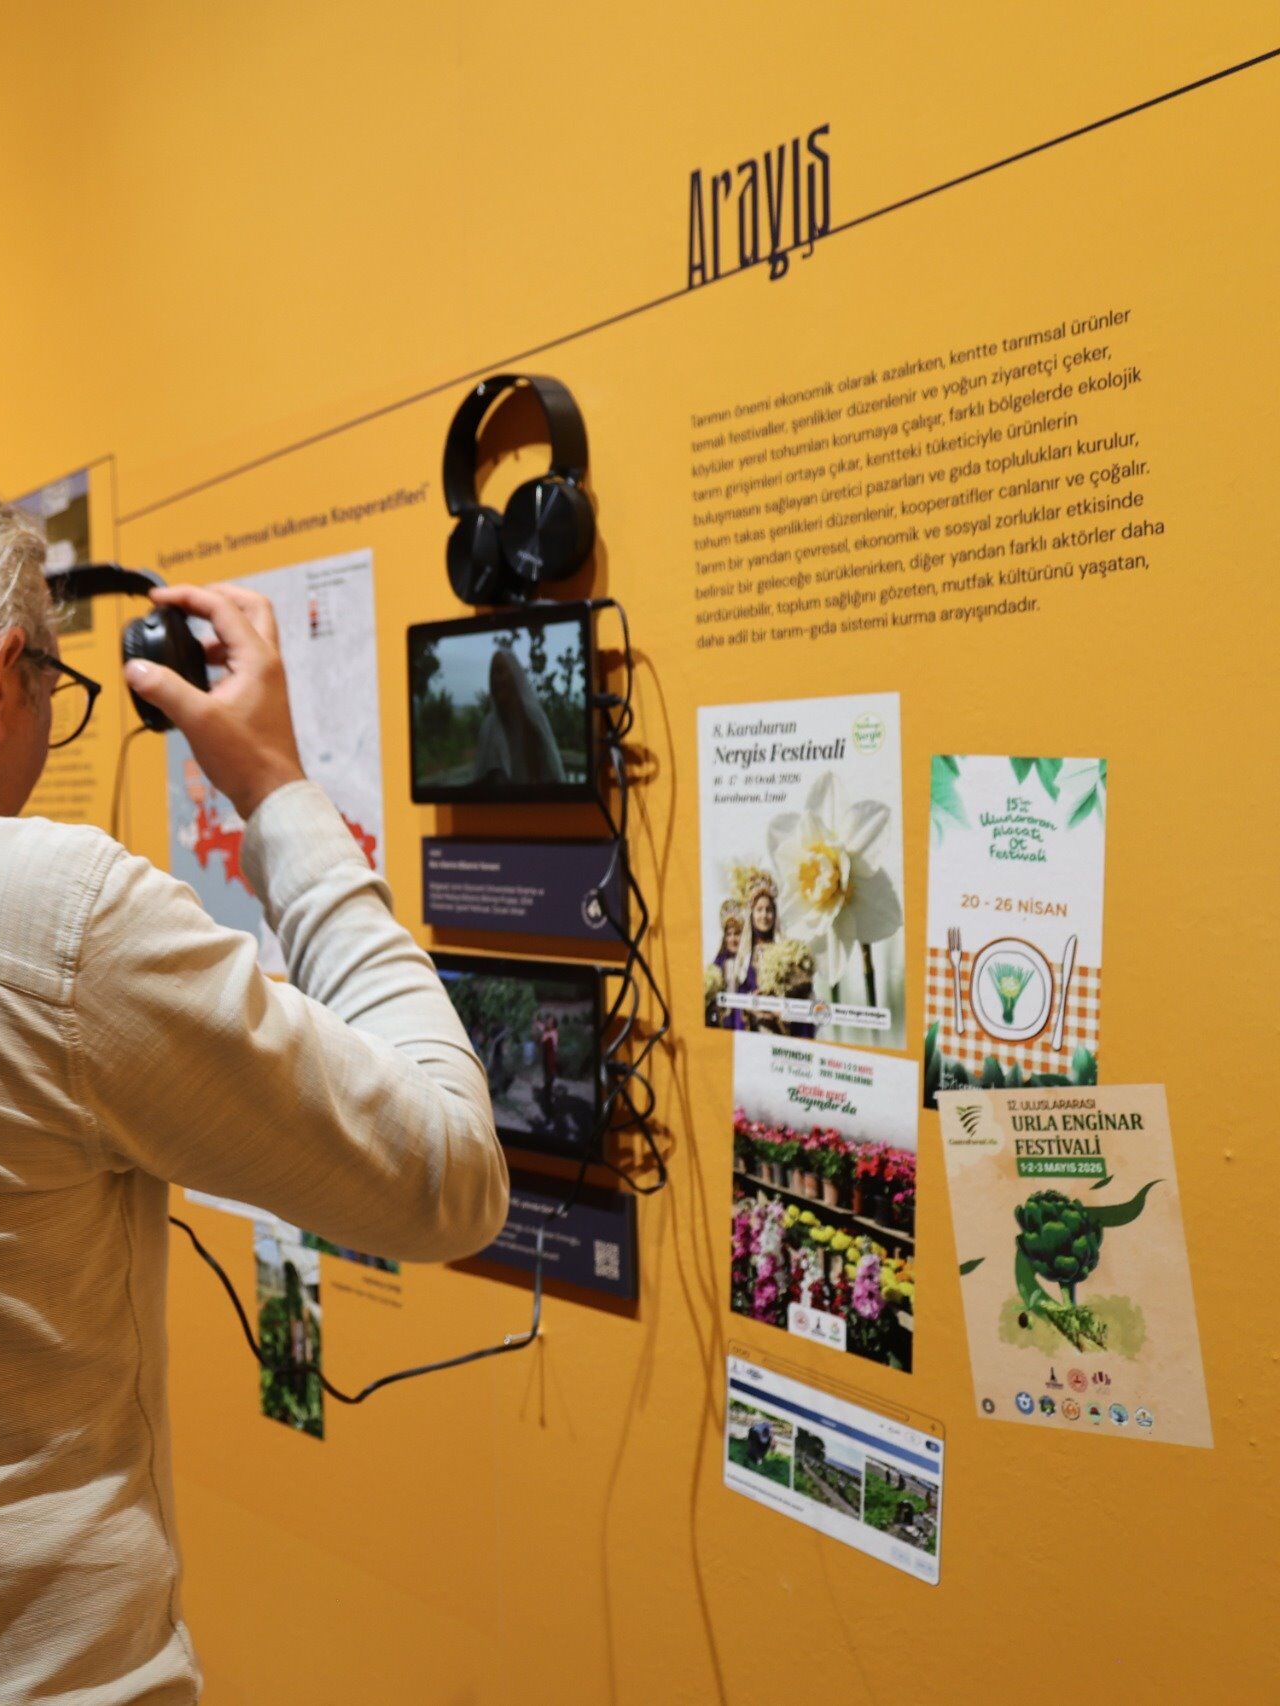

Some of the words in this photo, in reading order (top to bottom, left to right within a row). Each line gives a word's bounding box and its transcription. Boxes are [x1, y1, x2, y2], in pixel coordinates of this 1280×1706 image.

[687, 122, 830, 289] Arayış
[839, 371, 878, 391] olarak
[950, 343, 997, 364] kentte
[1002, 322, 1066, 351] tarımsal
[1071, 309, 1131, 335] ürünler
[792, 409, 842, 433] şenlikler
[922, 386, 938, 399] ve
[942, 374, 987, 398] yoğun
[991, 355, 1058, 384] ziyaretçi
[1062, 346, 1111, 372] çeker,
[832, 424, 898, 446] korumaya
[902, 413, 945, 435] çalışır,
[949, 402, 985, 421] farklı
[1078, 366, 1141, 394] ekolojik
[786, 466, 826, 482] ortaya
[829, 458, 862, 477] çıkar,
[867, 444, 921, 466] kentteki
[1007, 413, 1077, 438] ürünlerin
[821, 486, 862, 502] üretici
[866, 473, 924, 496] pazarları
[929, 469, 945, 482] ve
[950, 461, 981, 483] gıda
[1077, 432, 1139, 454] kurulur,
[999, 477, 1060, 498] canlanır
[1066, 473, 1084, 487] ve
[1089, 460, 1150, 487] çoğalır.
[795, 539, 850, 562] çevresel,
[855, 527, 919, 549] ekonomik
[924, 526, 940, 539] ve
[945, 515, 991, 536] sosyal
[995, 506, 1061, 528] zorluklar
[1066, 491, 1144, 517] etkisinde
[909, 553, 943, 572] diğer
[950, 544, 1004, 566] yandan
[1010, 536, 1047, 554] farklı
[1052, 527, 1115, 549] aktörler
[1121, 520, 1164, 539] daha
[824, 590, 875, 609] sağlığını
[880, 583, 938, 604] gözeten,
[942, 573, 993, 591] mutfak
[999, 563, 1073, 584] kültürünü
[1079, 555, 1149, 579] yaşatan,
[841, 616, 888, 632] sistemi
[892, 611, 935, 626] kurma
[727, 719, 797, 738] Karaburun
[714, 742, 767, 769] Nergis
[770, 737, 846, 763] Festivali
[989, 844, 1047, 862] Festivali
[1009, 837, 1027, 850] Ot
[960, 893, 980, 909] 20
[995, 896, 1013, 912] 26
[1018, 896, 1068, 917] NİSAN
[1011, 1114, 1058, 1132] URLA
[1062, 1110, 1144, 1131] ENGİNAR
[1020, 1098, 1096, 1111] ULUSLARARASI
[1015, 1134, 1102, 1155] FESTİVALİ
[1044, 1162, 1077, 1174] MAYIS
